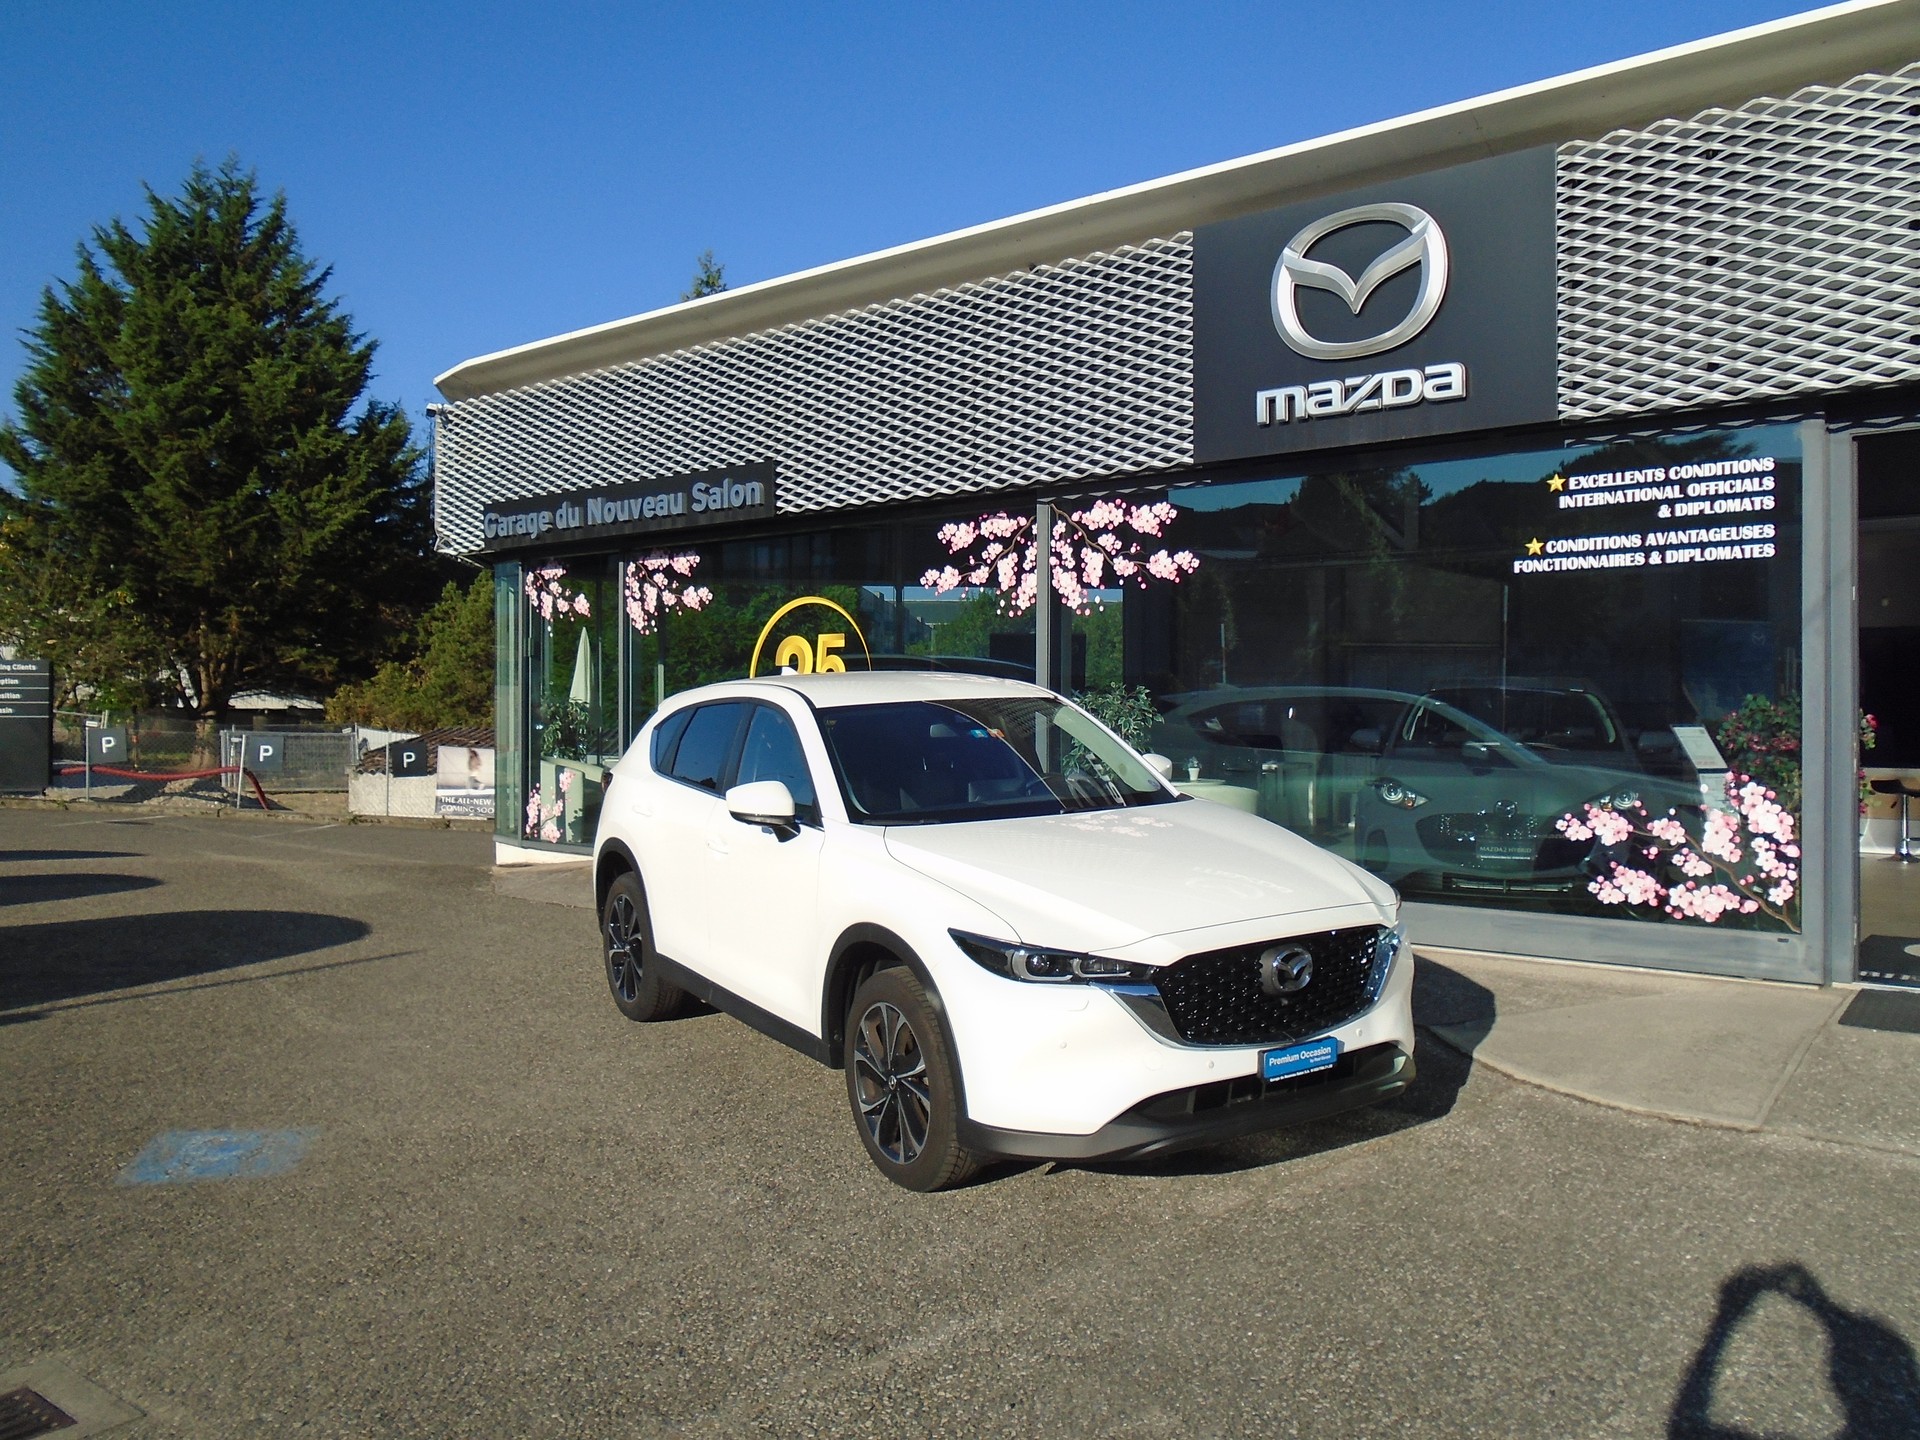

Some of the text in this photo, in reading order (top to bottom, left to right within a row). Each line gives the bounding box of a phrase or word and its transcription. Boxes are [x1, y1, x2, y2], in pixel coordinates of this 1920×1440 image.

[1569, 457, 1775, 491] EXCELLENTS CONDITIONS
[1559, 477, 1775, 509] INTERNATIONAL OFFICIALS
[484, 478, 764, 539] Garage du Nouveau Salon
[1658, 496, 1775, 519] & DIPLOMATS
[1545, 524, 1776, 554] CONDITIONS AVANTAGEUSES
[1513, 544, 1776, 574] FONCTIONNAIRES & DIPLOMATES
[101, 735, 115, 753] P
[259, 744, 273, 762] P
[403, 751, 416, 768] P
[441, 796, 492, 806] THE ALL-NEW
[441, 804, 475, 813] COMING
[1269, 1053, 1300, 1067] Premium
[1300, 1046, 1332, 1059] Occasion
